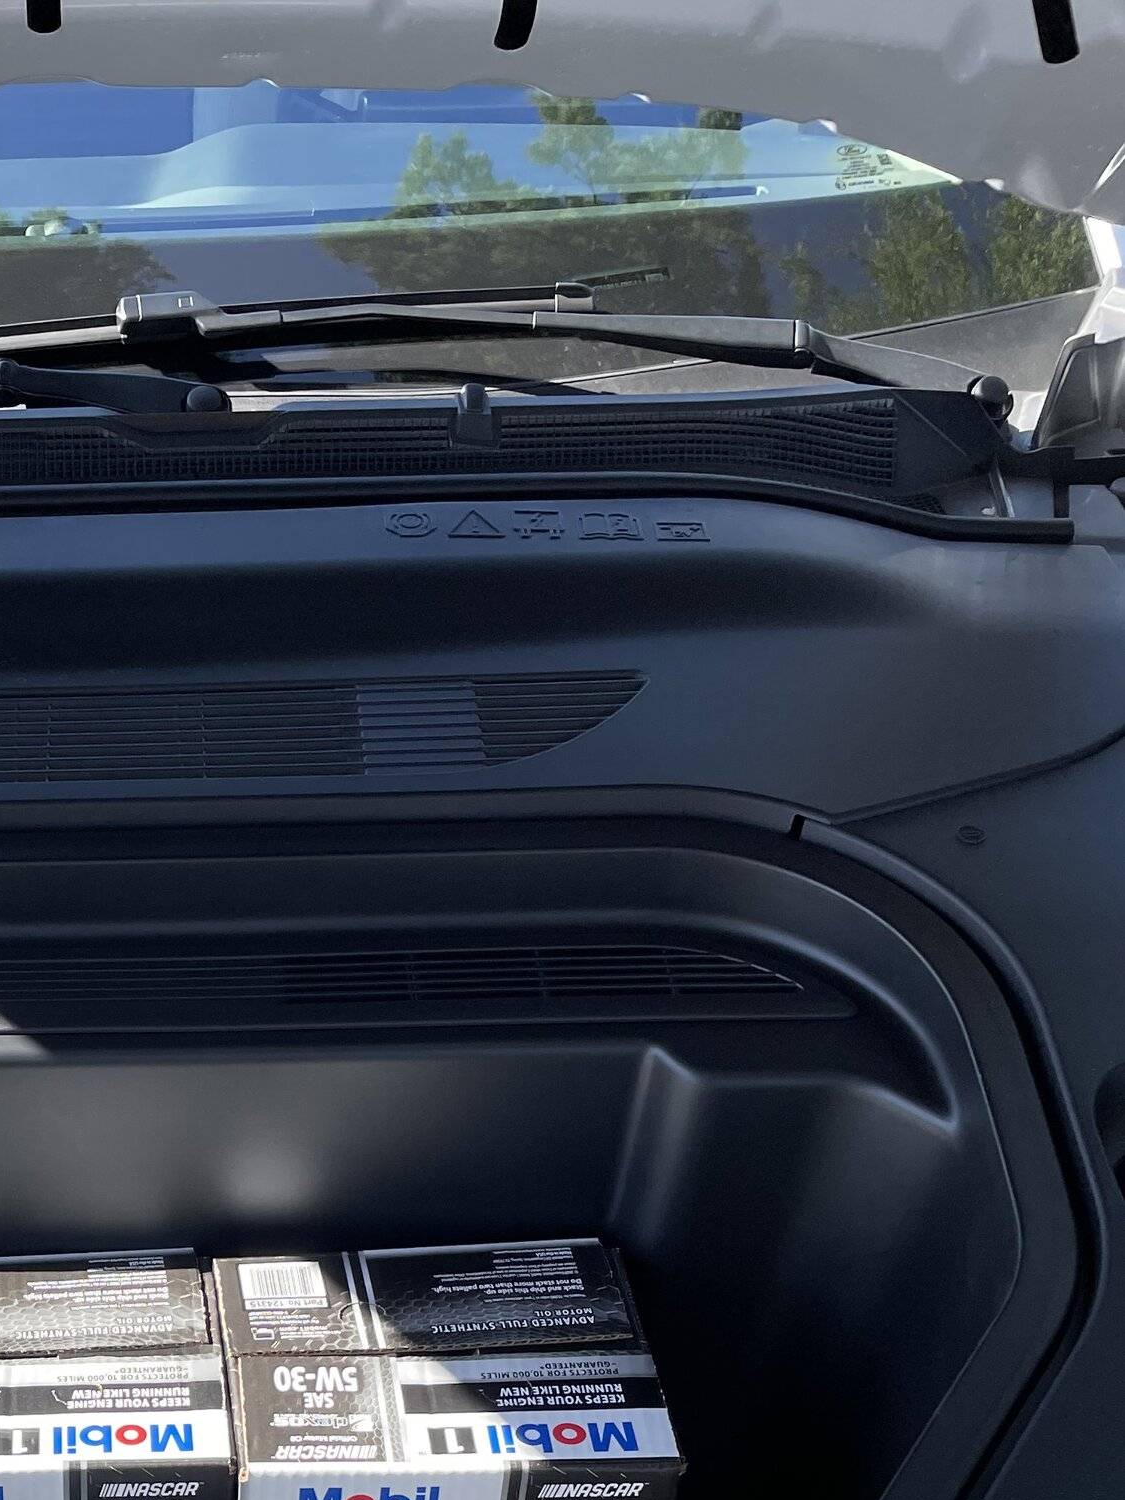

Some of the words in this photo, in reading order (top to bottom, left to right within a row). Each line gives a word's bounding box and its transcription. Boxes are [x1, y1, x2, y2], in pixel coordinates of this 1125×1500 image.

[305, 1299, 323, 1307] Part
[499, 1320, 527, 1328] FULL
[531, 1316, 594, 1327] ADVANCED
[15, 1328, 77, 1339] SYNTHETIC
[81, 1327, 108, 1335] FULL
[111, 1323, 173, 1334] ADVANCED
[431, 1322, 495, 1334] SYNTHETIC
[513, 1370, 543, 1378] 10,000
[569, 1368, 618, 1376] PROTECTS
[273, 1366, 358, 1392] 5W-30
[103, 1389, 130, 1398] LIKE
[132, 1387, 190, 1397] RUNNING
[500, 1386, 528, 1396] NEW
[532, 1385, 559, 1395] LIKE
[562, 1383, 622, 1394] RUNNING
[72, 1390, 102, 1399] NEW
[303, 1392, 334, 1408] SAE
[585, 1393, 625, 1404] KEEPS
[67, 1399, 113, 1409] ENGINE
[115, 1398, 150, 1408] YOUR
[152, 1397, 190, 1408] KEEPS
[496, 1396, 544, 1406] ENGINE
[547, 1395, 582, 1406] YOUR
[12, 1430, 28, 1454] 1
[53, 1424, 194, 1454] Mobil
[444, 1428, 464, 1454] 1
[486, 1422, 639, 1454] Mobil
[274, 1445, 350, 1460] NASCAR
[123, 1482, 199, 1497] NASCAR
[563, 1483, 644, 1498] NASCAR
